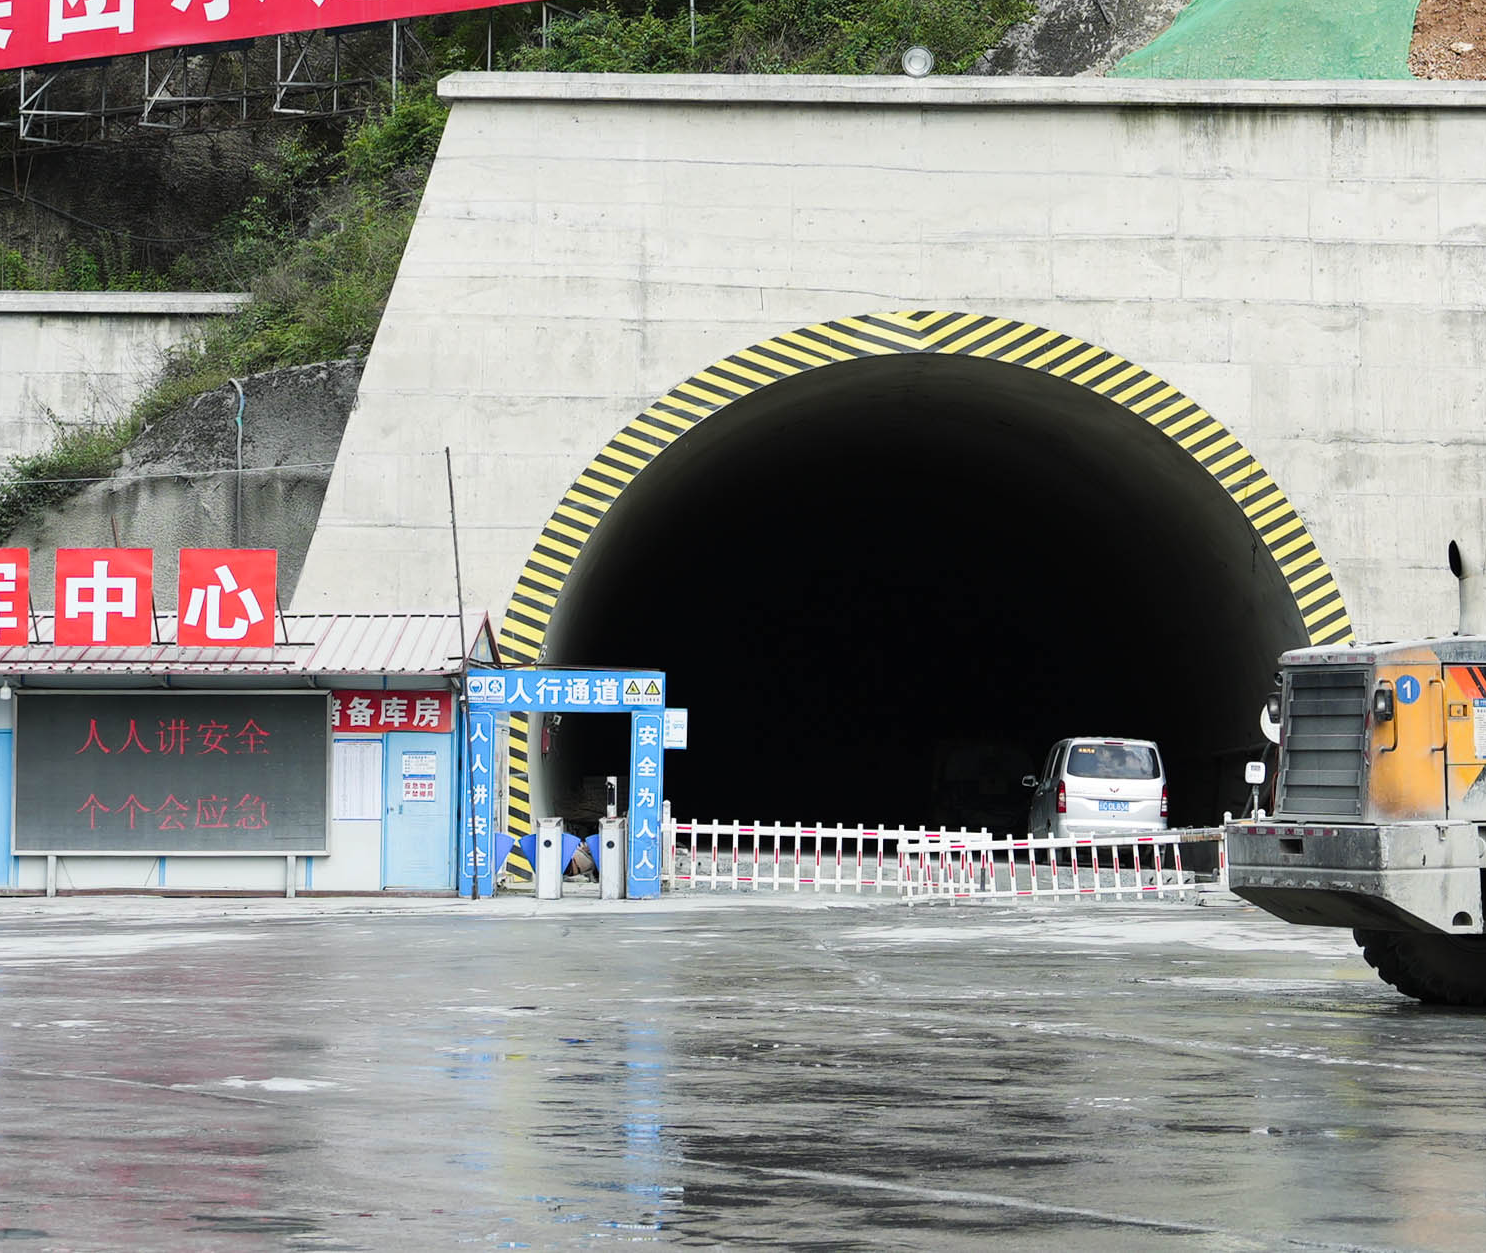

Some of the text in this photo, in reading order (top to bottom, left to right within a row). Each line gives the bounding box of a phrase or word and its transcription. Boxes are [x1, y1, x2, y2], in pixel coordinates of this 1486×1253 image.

[507, 677, 619, 705] 人行通道
[1402, 680, 1412, 698] 1
[77, 718, 271, 755] 人人讲安全
[77, 793, 270, 830] 个个会应急
[466, 723, 488, 867] 人人讲安全
[634, 725, 658, 870] 安全为人人
